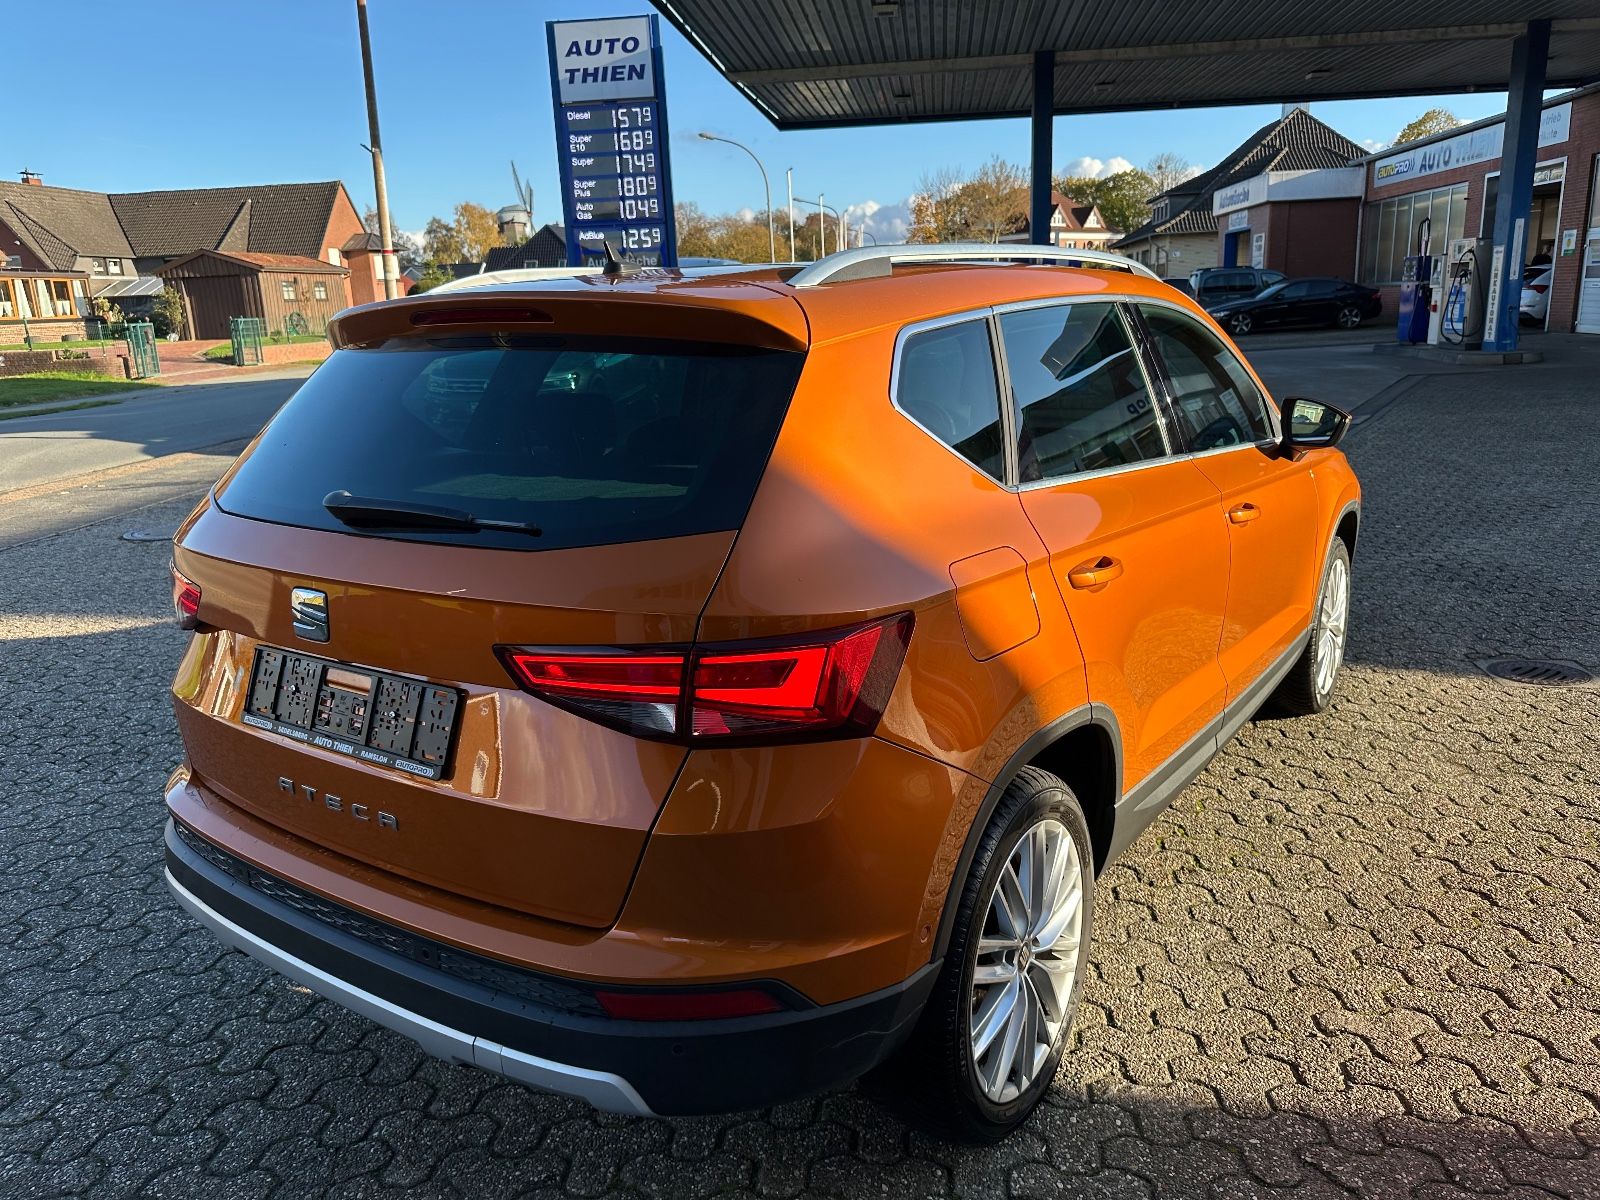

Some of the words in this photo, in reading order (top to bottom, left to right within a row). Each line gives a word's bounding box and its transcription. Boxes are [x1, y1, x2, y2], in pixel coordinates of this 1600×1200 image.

[565, 36, 640, 57] AUTO
[565, 63, 647, 85] THIEN
[567, 111, 591, 120] Diesel
[611, 107, 652, 128] 1579
[569, 134, 592, 144] Super
[614, 130, 653, 151] 1689
[570, 144, 586, 152] E10
[571, 157, 594, 167] Super
[615, 153, 655, 174] 1749
[1419, 144, 1452, 173] AUTO
[573, 179, 596, 190] Super
[617, 175, 657, 197] 1809
[574, 189, 591, 197] Plus
[576, 202, 594, 211] Auto
[619, 198, 658, 219] 1049
[576, 211, 593, 220] Gas
[578, 231, 605, 241] AdBlue
[621, 227, 661, 249] 1259
[314, 736, 333, 748] AUTO
[333, 740, 354, 754] THIEN
[360, 750, 388, 764] RAMSLOH
[279, 776, 400, 832] ATECA
